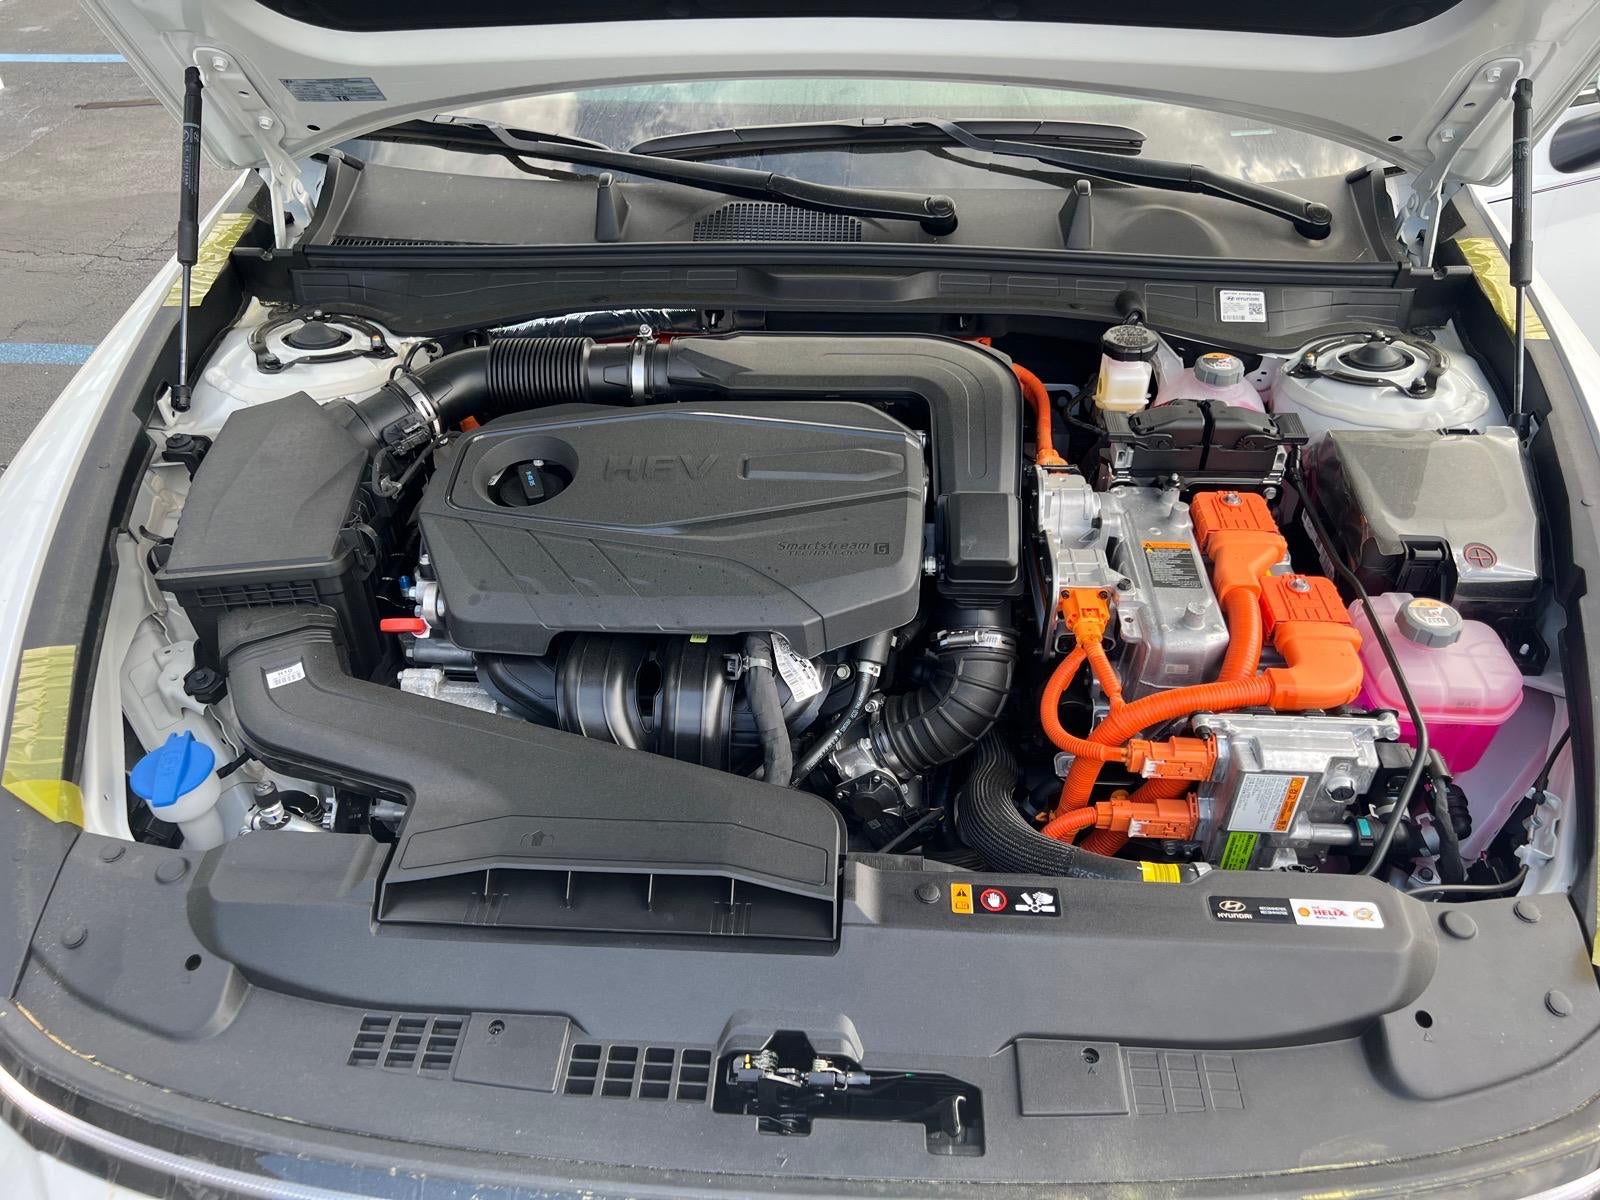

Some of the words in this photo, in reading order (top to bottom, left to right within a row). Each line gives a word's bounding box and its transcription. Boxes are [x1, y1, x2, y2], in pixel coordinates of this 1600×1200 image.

[603, 455, 720, 480] HEV
[778, 541, 870, 551] Smartstream
[1217, 912, 1253, 920] HYUNDAI
[1313, 908, 1348, 917] HELIX
